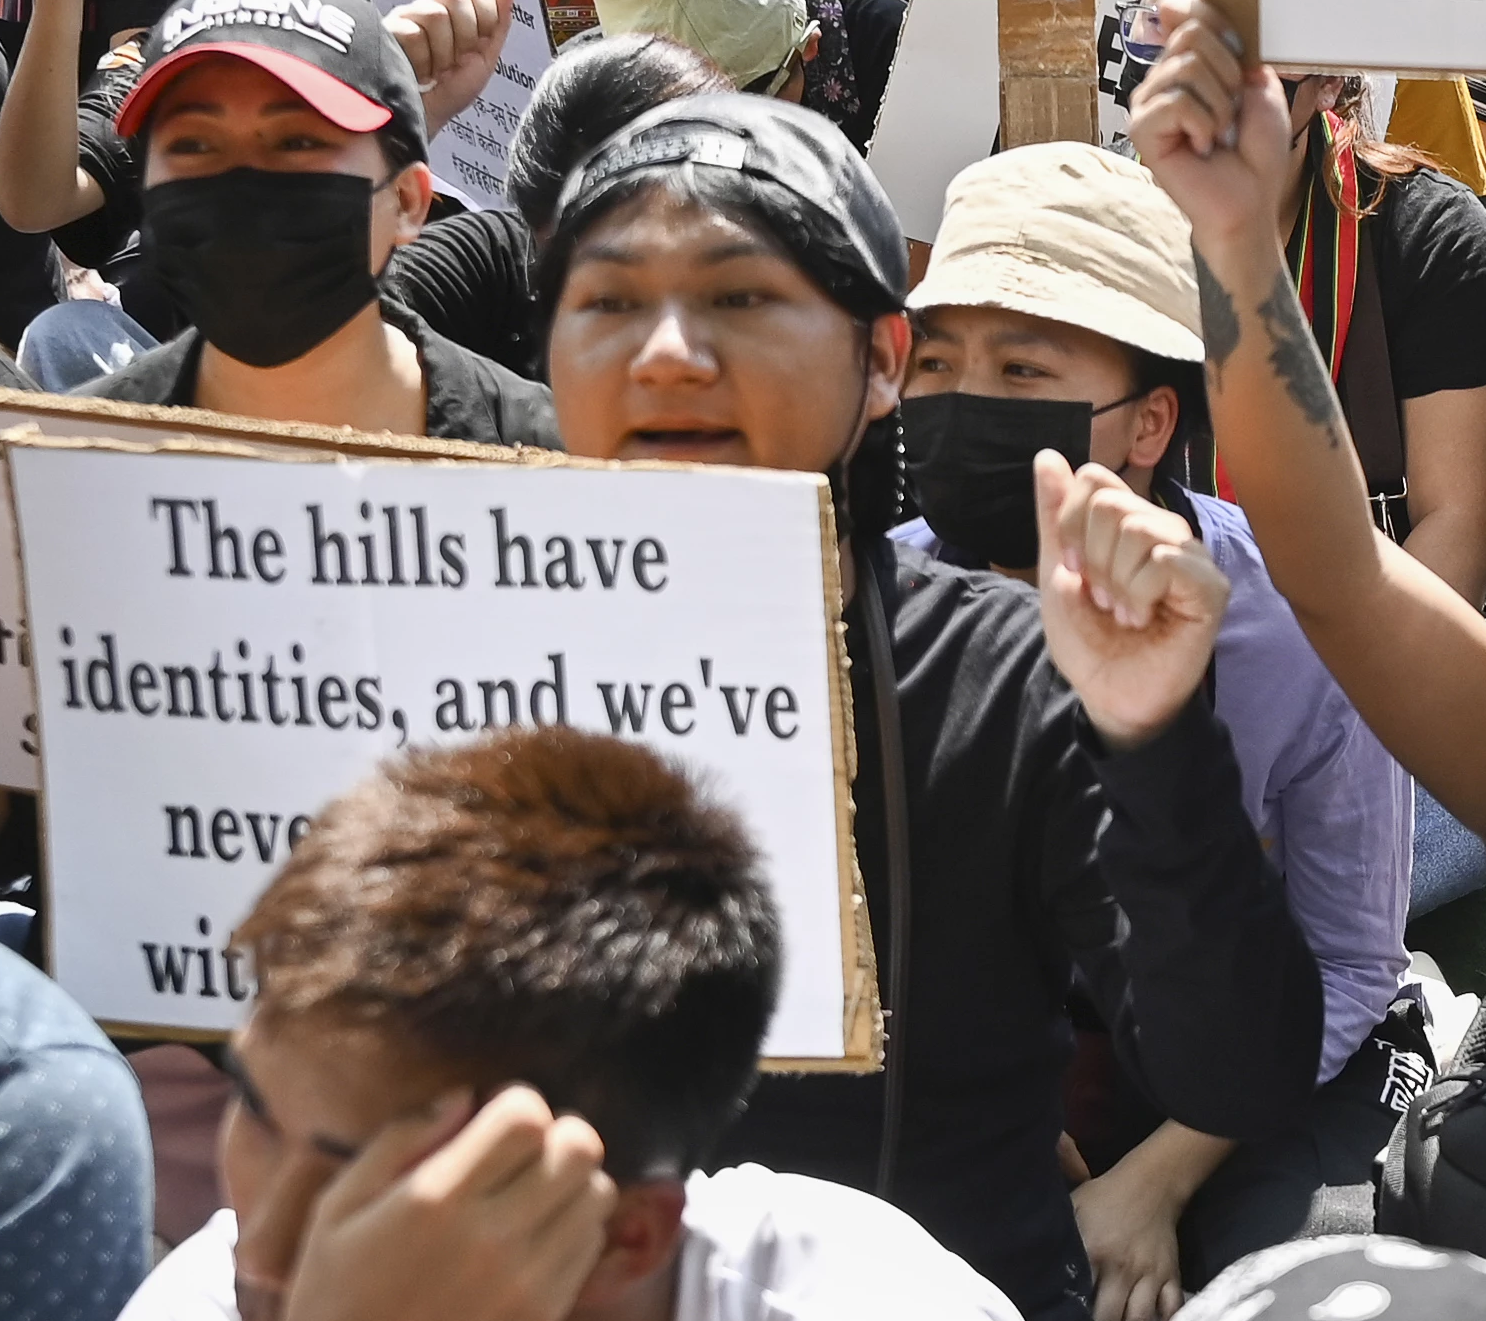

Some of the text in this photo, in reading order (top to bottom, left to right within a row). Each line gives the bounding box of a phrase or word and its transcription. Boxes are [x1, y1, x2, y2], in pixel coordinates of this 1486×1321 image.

[149, 496, 668, 593] The hills have
[58, 625, 800, 749] identities, and we've
